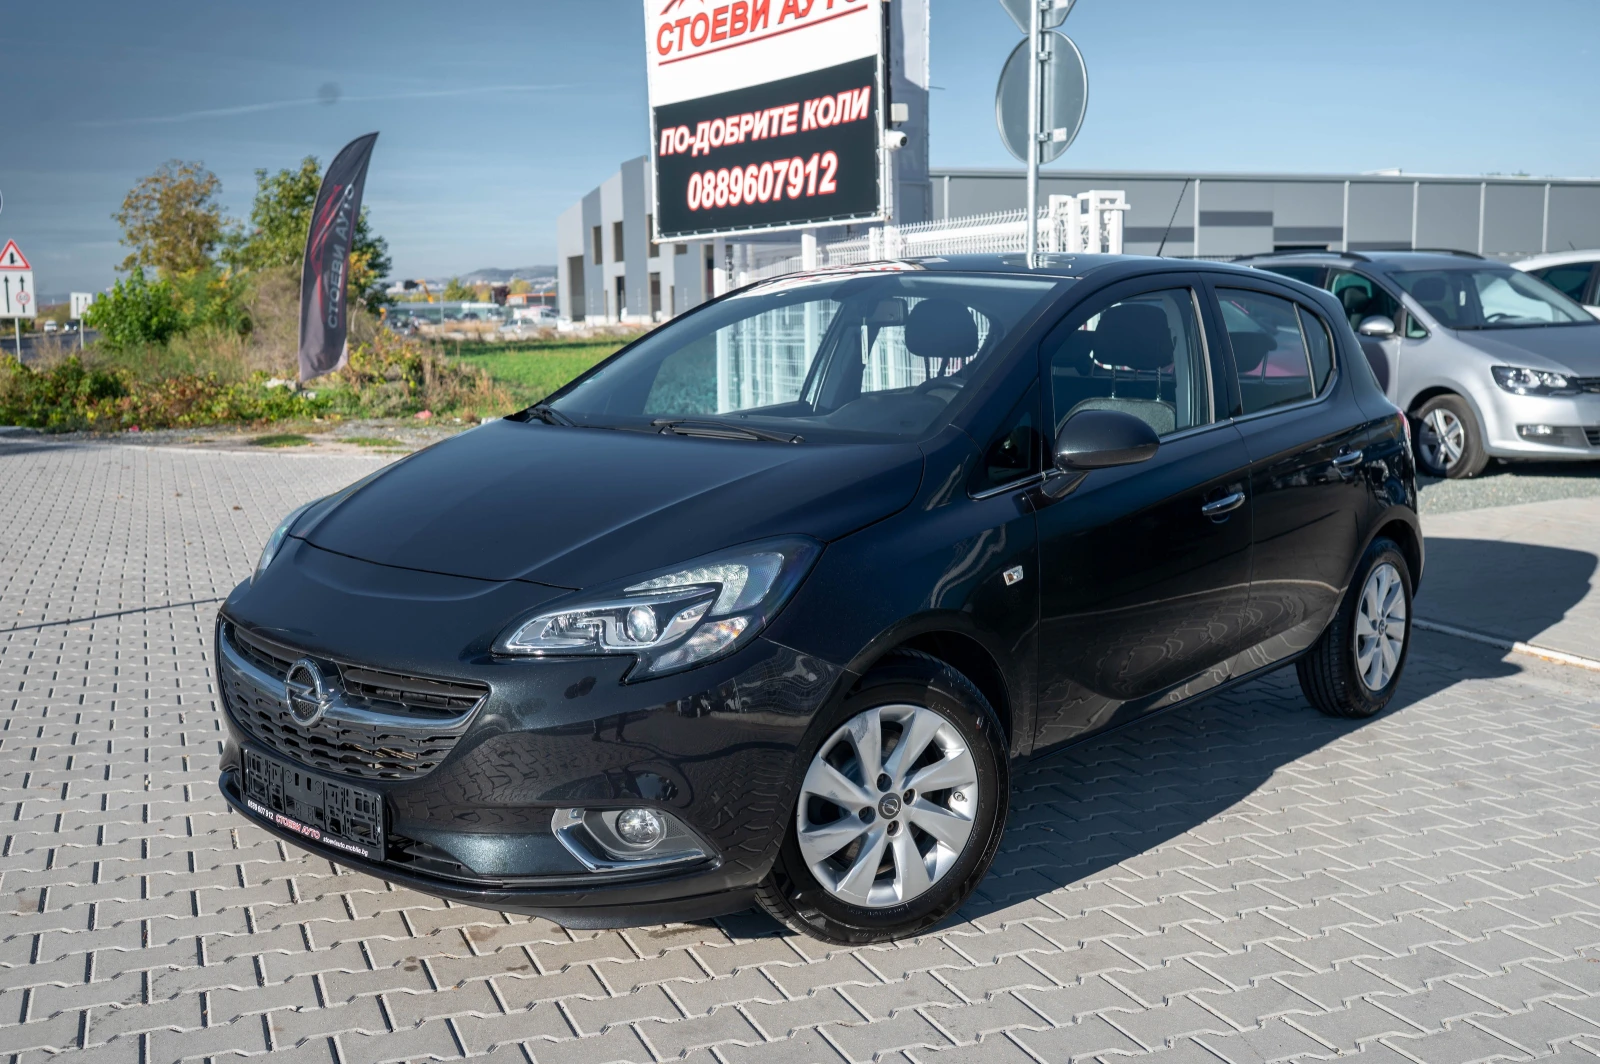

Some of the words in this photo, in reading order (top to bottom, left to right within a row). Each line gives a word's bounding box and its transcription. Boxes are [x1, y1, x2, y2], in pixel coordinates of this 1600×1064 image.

[657, 0, 771, 56] СТОЕВИ
[777, 0, 858, 25] АУ
[660, 102, 800, 156] ПО-ДОБРИТЕ
[801, 86, 871, 131] КОЛИ
[687, 151, 838, 211] 0889607912
[328, 244, 345, 328] СТОЕВИ
